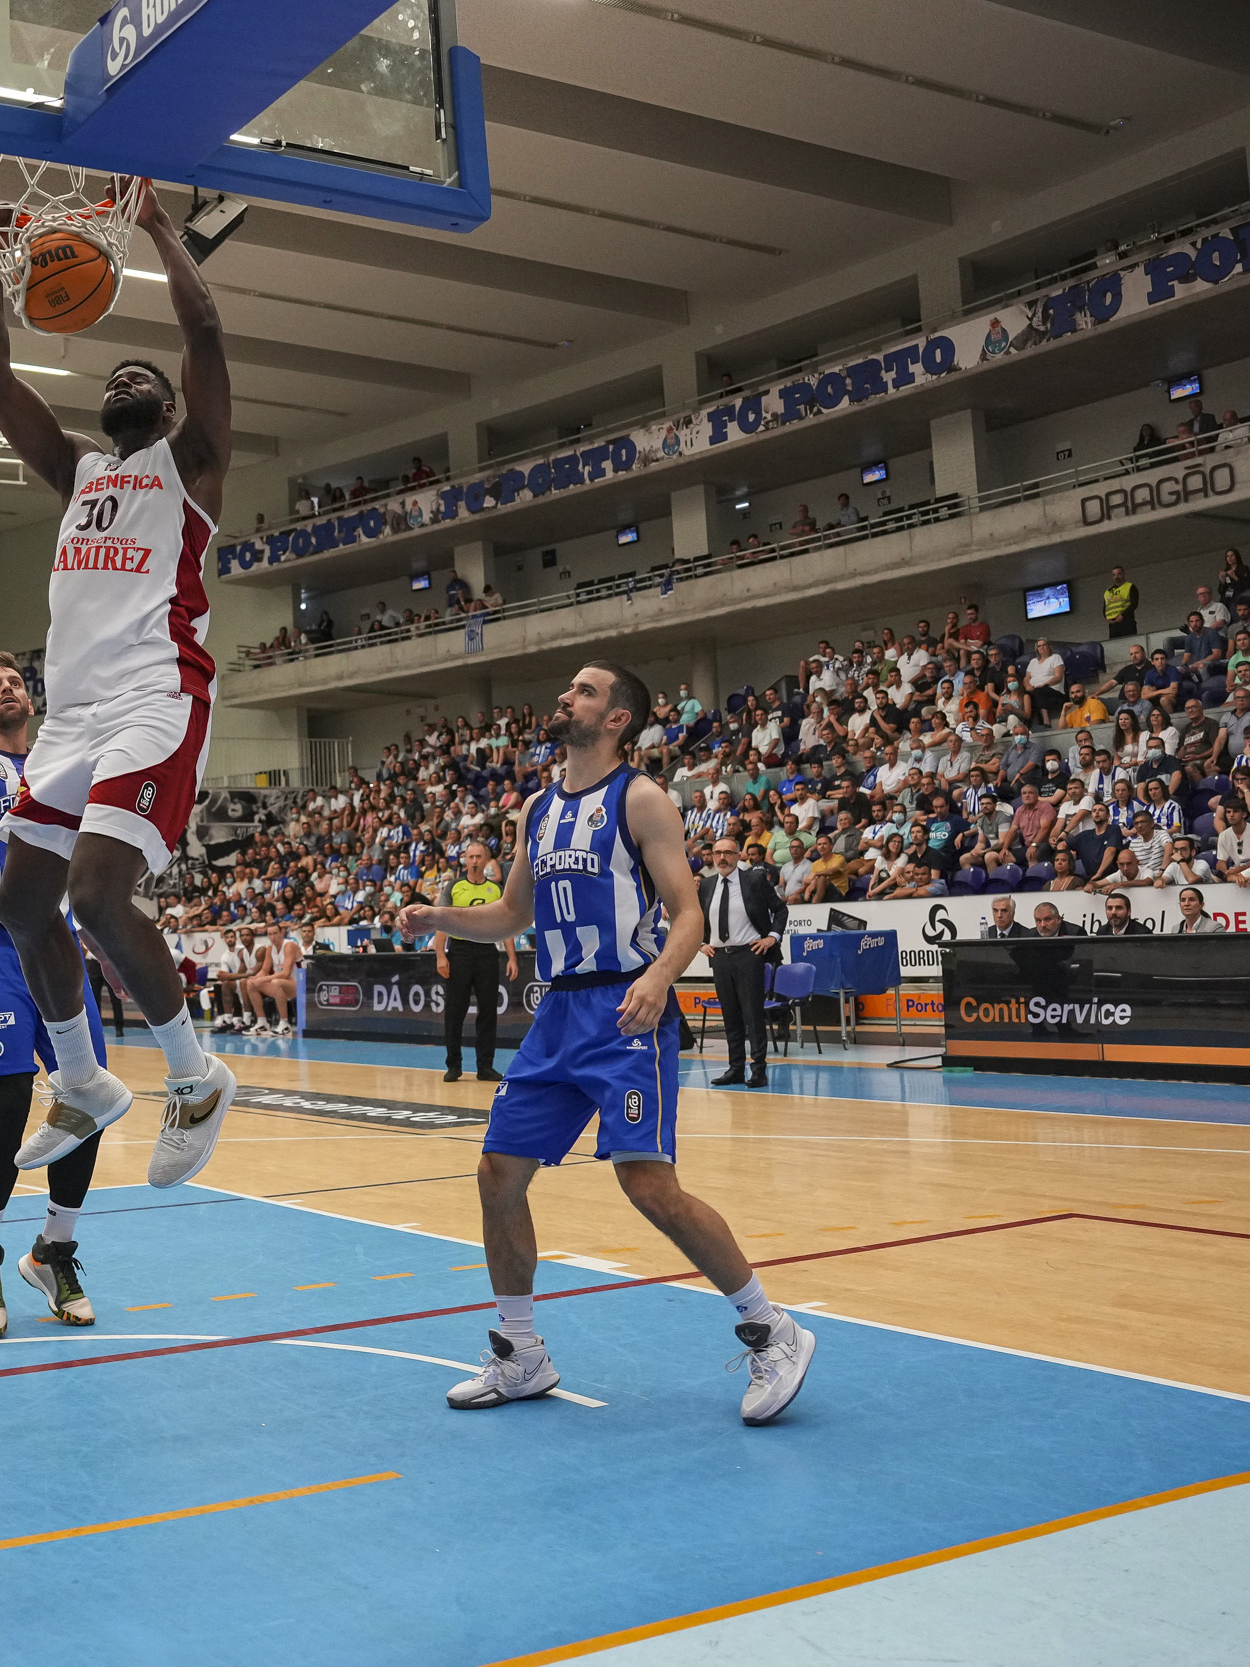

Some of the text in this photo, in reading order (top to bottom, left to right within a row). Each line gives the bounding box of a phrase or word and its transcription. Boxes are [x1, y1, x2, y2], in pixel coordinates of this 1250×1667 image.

[1048, 273, 1123, 338] FC
[707, 335, 956, 445] FC PORTO
[81, 474, 163, 494] BENFICA
[440, 437, 637, 520] FC PORTO
[1081, 462, 1236, 526] DRAGÃO
[75, 495, 118, 532] 30
[217, 508, 387, 577] FC PORTO
[551, 880, 576, 923] 10
[789, 919, 812, 927] PORTO
[373, 975, 403, 1012] DÁ
[409, 985, 425, 1012] O
[906, 998, 944, 1013] Porto
[960, 996, 1132, 1025] ContiService
